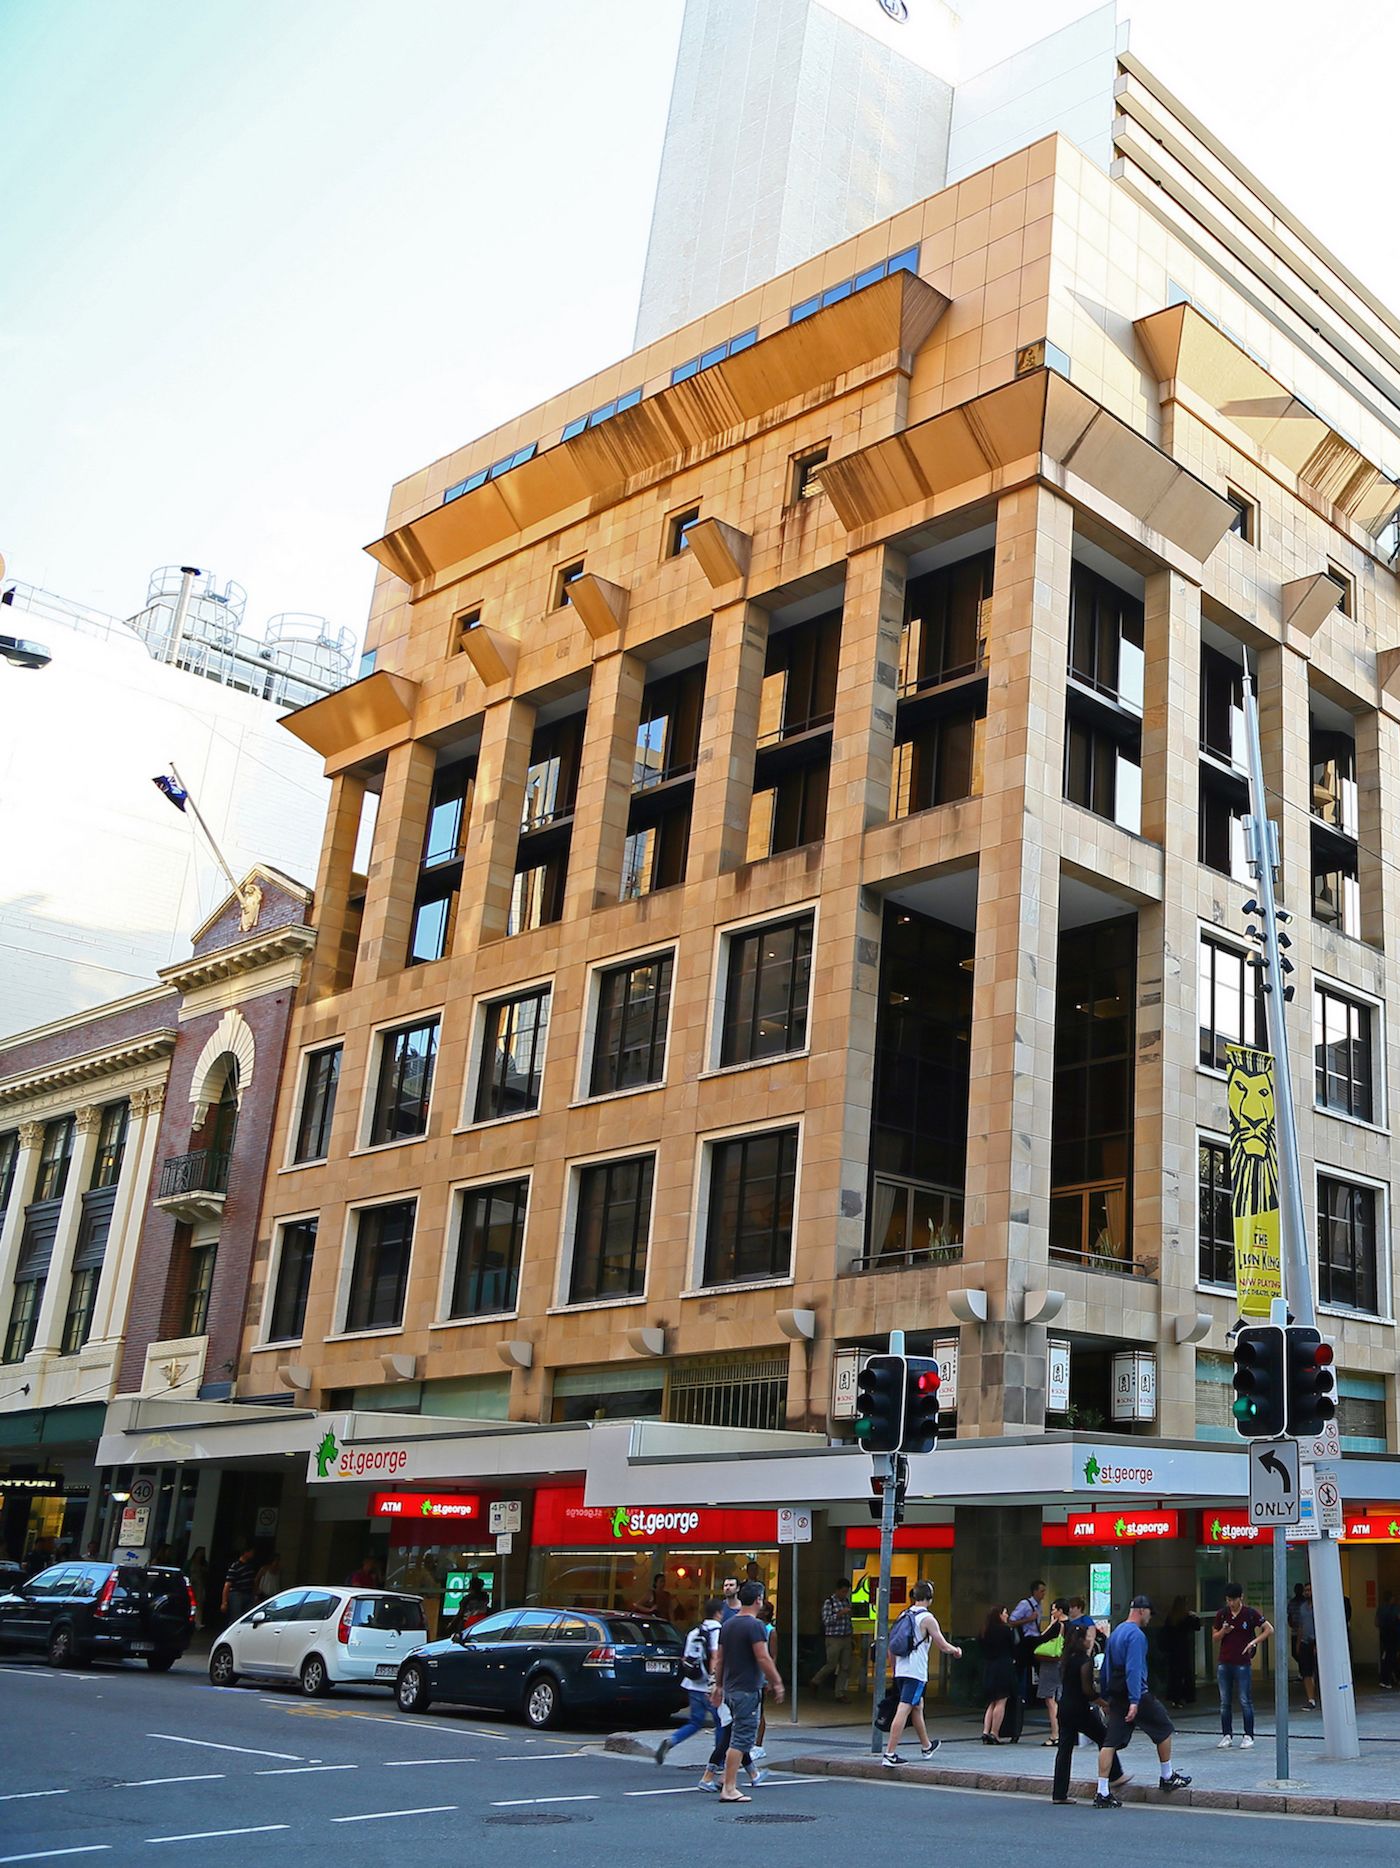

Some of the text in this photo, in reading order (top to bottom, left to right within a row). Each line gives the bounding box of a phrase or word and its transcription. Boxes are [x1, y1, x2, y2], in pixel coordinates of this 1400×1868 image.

[1254, 1233, 1267, 1246] THE
[340, 1450, 407, 1475] st.george
[1101, 1465, 1153, 1484] st.george
[134, 1485, 151, 1498] 40
[380, 1502, 472, 1516] ATM st.george
[1254, 1501, 1295, 1517] ONLY
[630, 1510, 699, 1535] st.george
[1074, 1522, 1170, 1536] ATM st.george
[1351, 1524, 1371, 1535] ATM
[1221, 1524, 1259, 1540] st.george
